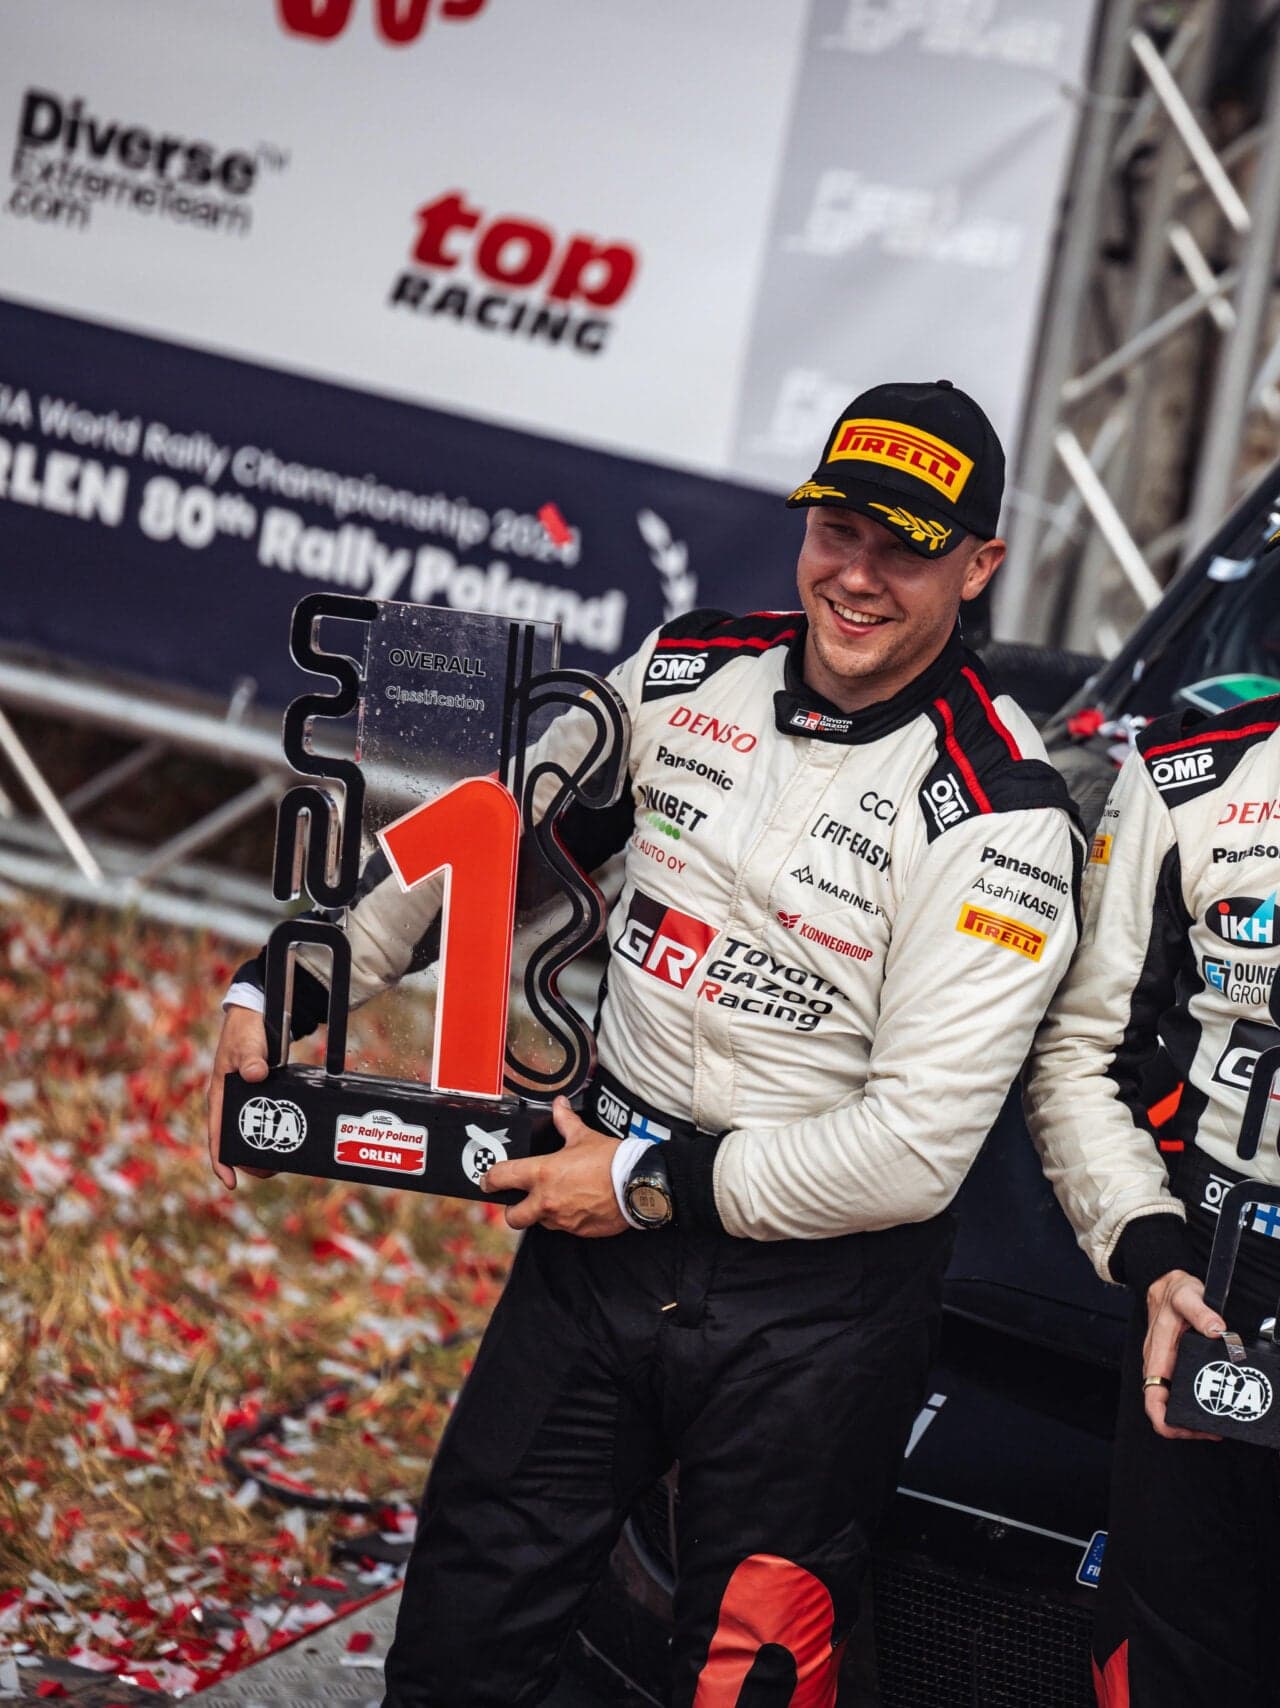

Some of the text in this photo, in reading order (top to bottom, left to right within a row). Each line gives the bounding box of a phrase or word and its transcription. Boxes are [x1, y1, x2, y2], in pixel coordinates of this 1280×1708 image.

[22, 87, 257, 197] Diverse
[408, 187, 641, 312] top
[386, 267, 611, 356] RACING
[38, 394, 142, 458] World
[142, 420, 231, 487] Rally
[230, 444, 492, 552] Championship
[836, 425, 962, 488] PIRELLI
[257, 504, 413, 603] Rally
[410, 543, 628, 655] Poland
[388, 647, 487, 678] OVERALL
[648, 657, 706, 680] OMP
[384, 684, 486, 712] Classification
[667, 705, 758, 754] DENSO
[1152, 748, 1215, 786] OMP
[640, 839, 666, 863] AUTO
[666, 856, 687, 874] OY
[980, 846, 1070, 895] Panasonic
[971, 877, 1060, 922] AsahiKASEI
[376, 776, 521, 1099] 1
[798, 922, 875, 963] KONNEGROUP
[963, 909, 1043, 956] PIRELLI
[706, 958, 834, 1016] GAZOO
[725, 936, 852, 1002] TOYOTA
[696, 980, 823, 1032] Racing
[358, 1126, 385, 1141] Rally
[385, 1130, 424, 1145] Poland
[596, 1094, 628, 1130] OMP
[358, 1147, 403, 1165] ORLEN
